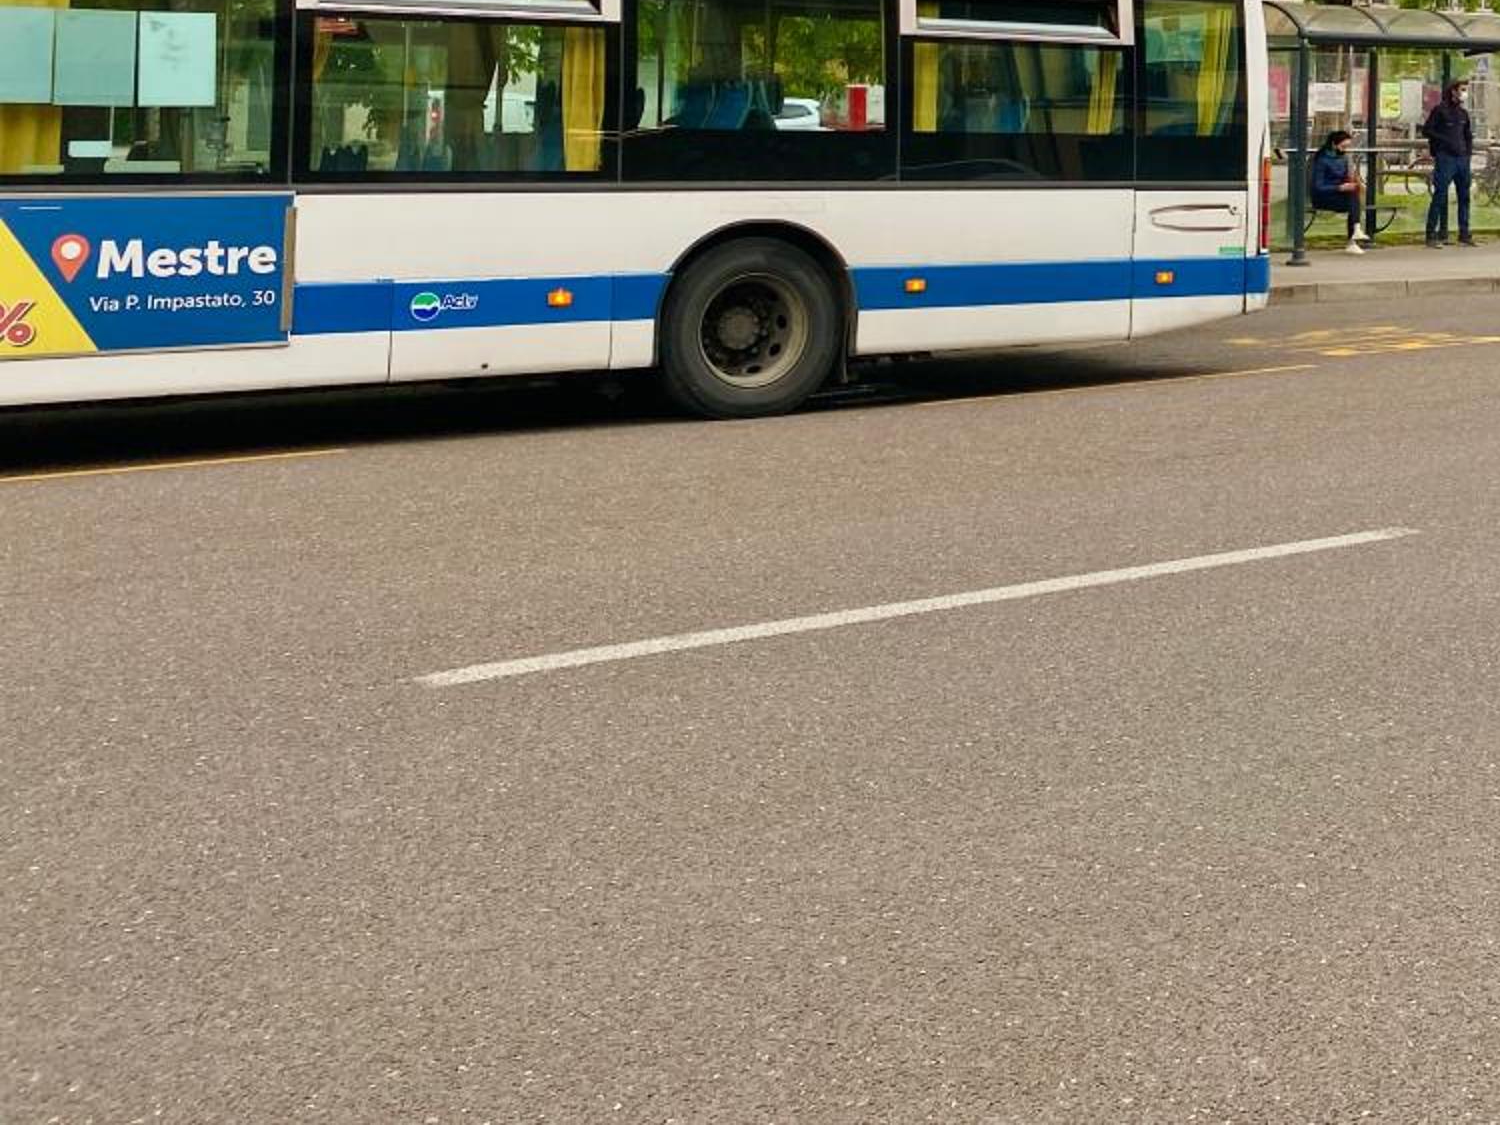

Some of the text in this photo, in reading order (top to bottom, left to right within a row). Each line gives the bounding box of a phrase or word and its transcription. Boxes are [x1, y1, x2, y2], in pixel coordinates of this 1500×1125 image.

[97, 239, 277, 278] Mestre
[90, 291, 275, 312] Via P. Impastato, 30
